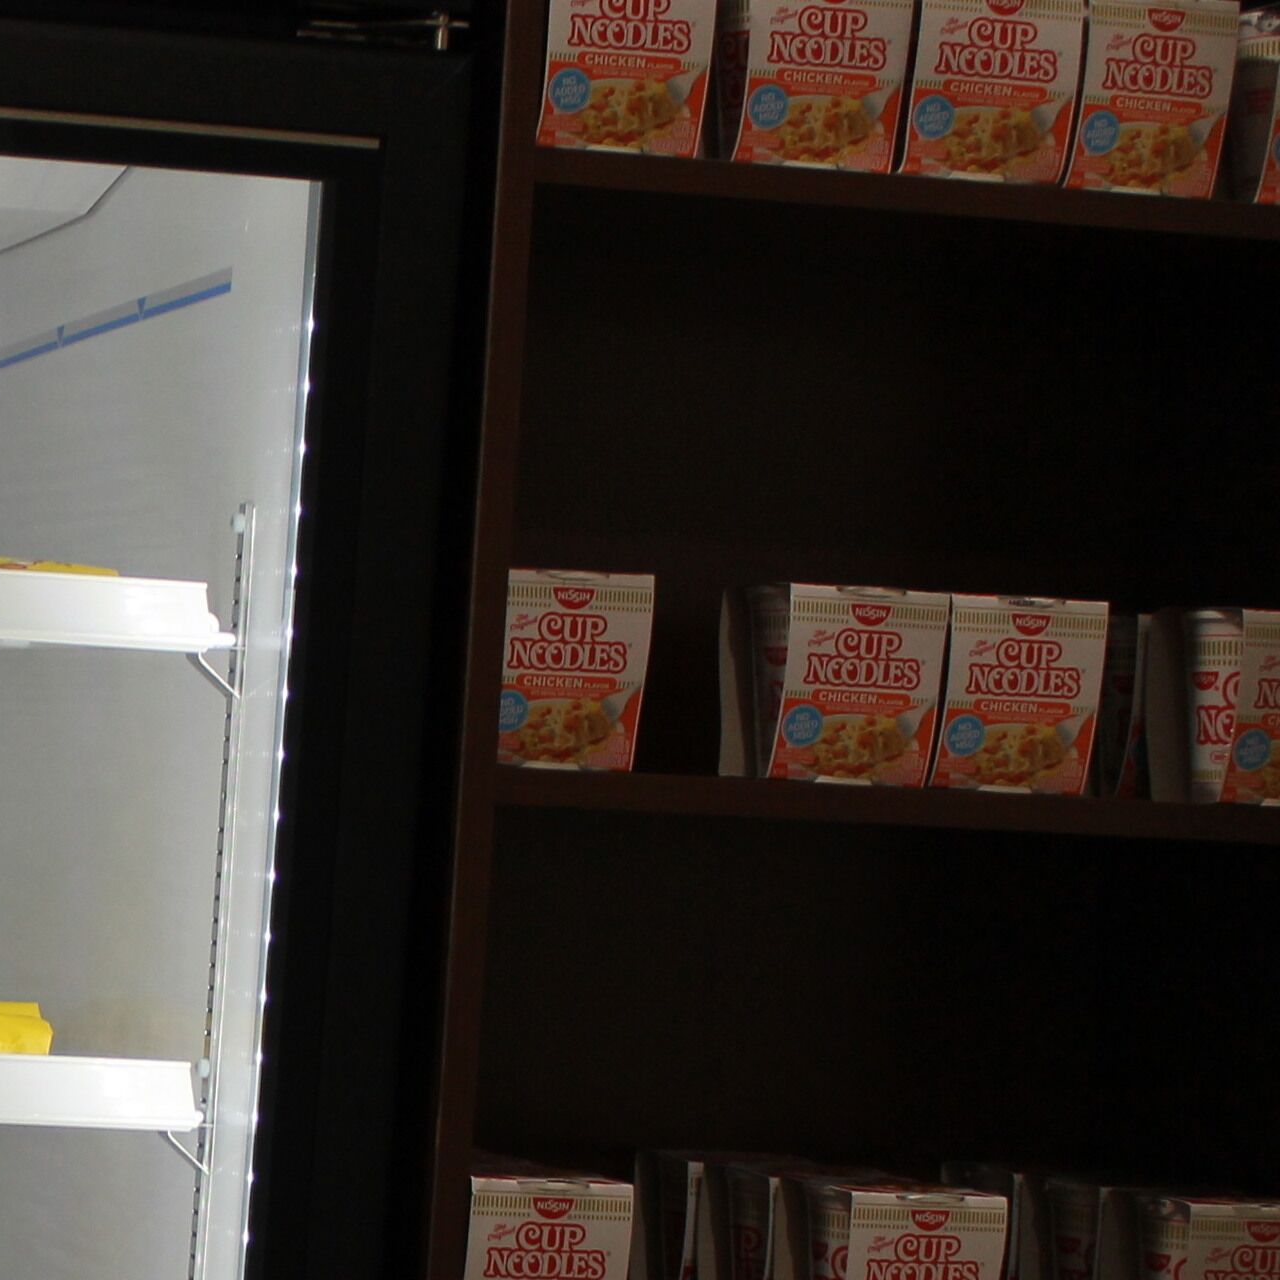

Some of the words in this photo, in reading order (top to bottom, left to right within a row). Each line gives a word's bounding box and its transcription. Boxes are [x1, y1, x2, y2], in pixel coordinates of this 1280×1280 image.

[568, 14, 692, 52] NOODLES
[799, 5, 868, 38] CUP
[968, 17, 1037, 50] CUP
[585, 54, 646, 69] CHICKEN
[768, 32, 886, 69] NOODLES
[935, 44, 1058, 82] NOODLES
[1133, 34, 1195, 65] CUP
[784, 71, 842, 86] CHICKEN
[950, 82, 1012, 96] CHICKEN
[1102, 59, 1213, 98] NOODLES
[1115, 98, 1170, 112] CHICKEN
[557, 589, 591, 602] NISSIN
[855, 606, 887, 620] NISSIN
[1015, 616, 1047, 629] NISSIN
[540, 613, 607, 644] CUP
[835, 628, 902, 658] CUP
[508, 638, 627, 673] NOODLES
[996, 638, 1062, 668] CUP
[523, 676, 584, 689] CHICKEN
[803, 653, 921, 690] NOODLES
[967, 663, 1081, 698] NOODLES
[818, 691, 878, 704] CHICKEN
[980, 701, 1039, 713] CHICKEN
[537, 1200, 570, 1212] NISSIN
[914, 1212, 946, 1224] NISSIN
[515, 1221, 586, 1252] CUP
[895, 1234, 961, 1263] CUP
[1231, 1245, 1280, 1272] CU
